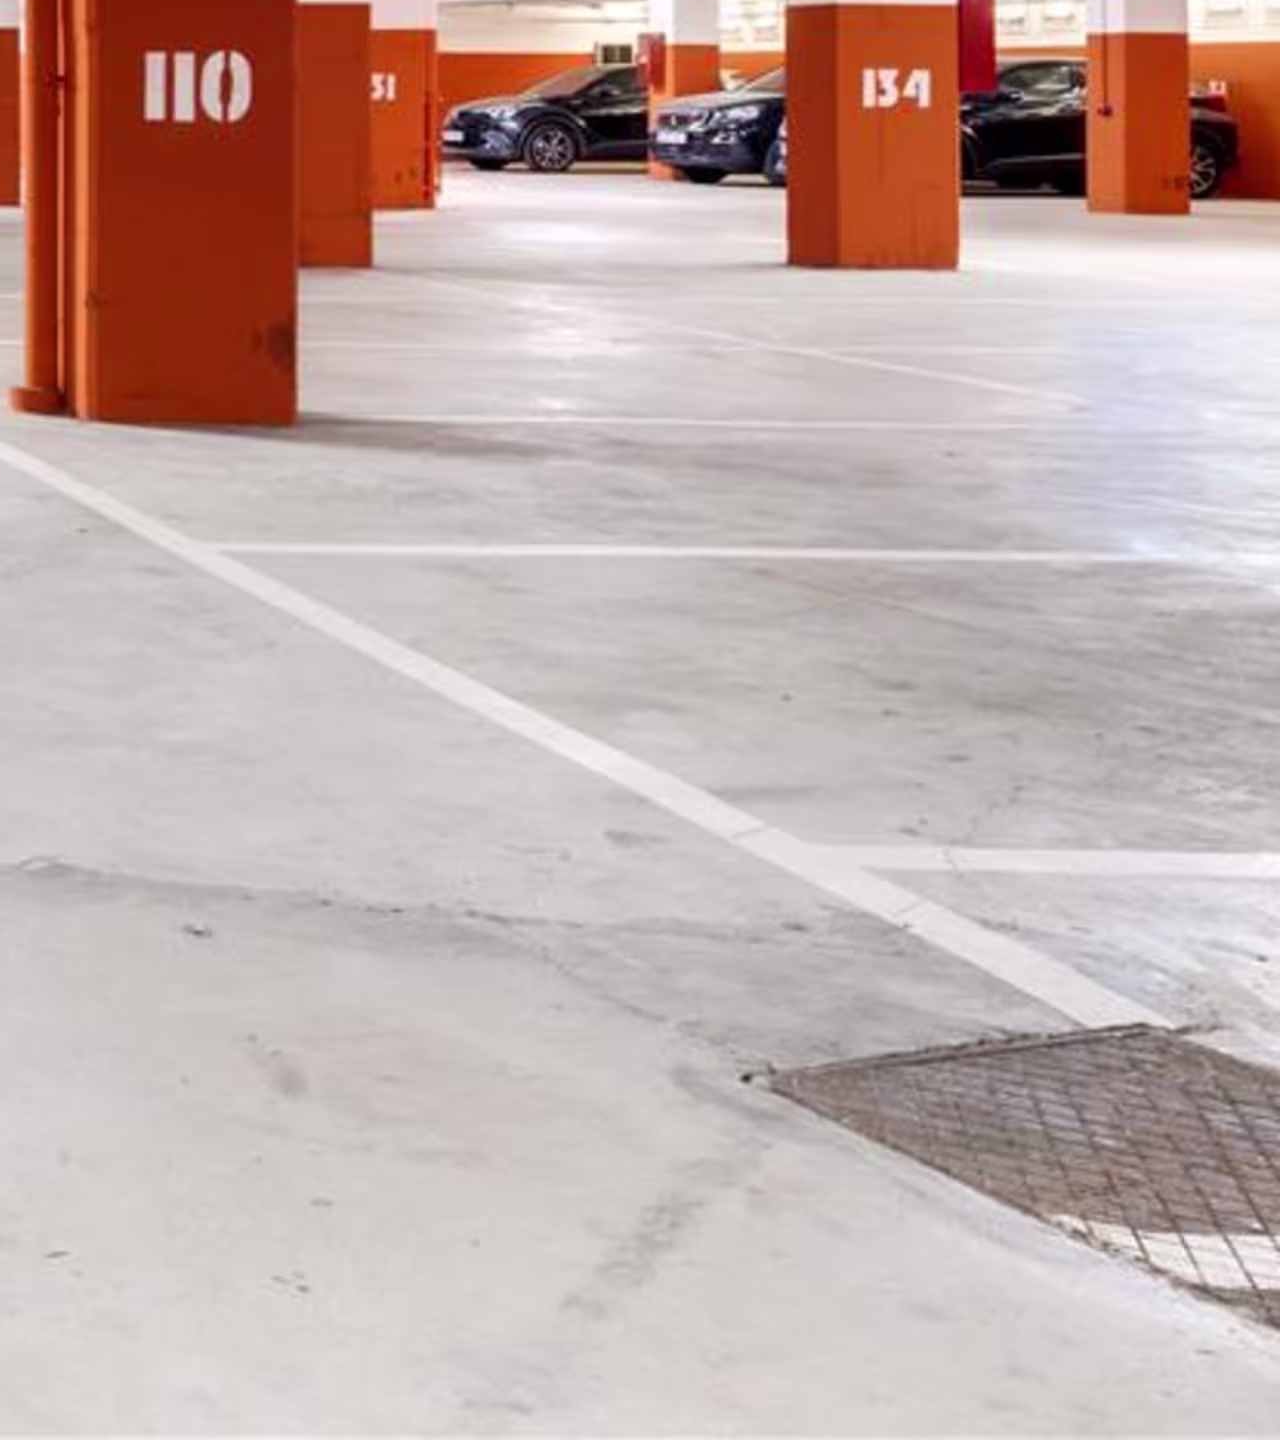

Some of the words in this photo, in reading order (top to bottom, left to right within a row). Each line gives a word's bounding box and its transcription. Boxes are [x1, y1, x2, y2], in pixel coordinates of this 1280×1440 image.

[144, 50, 253, 121] 110
[371, 72, 396, 101] 31
[862, 68, 931, 108] 134
